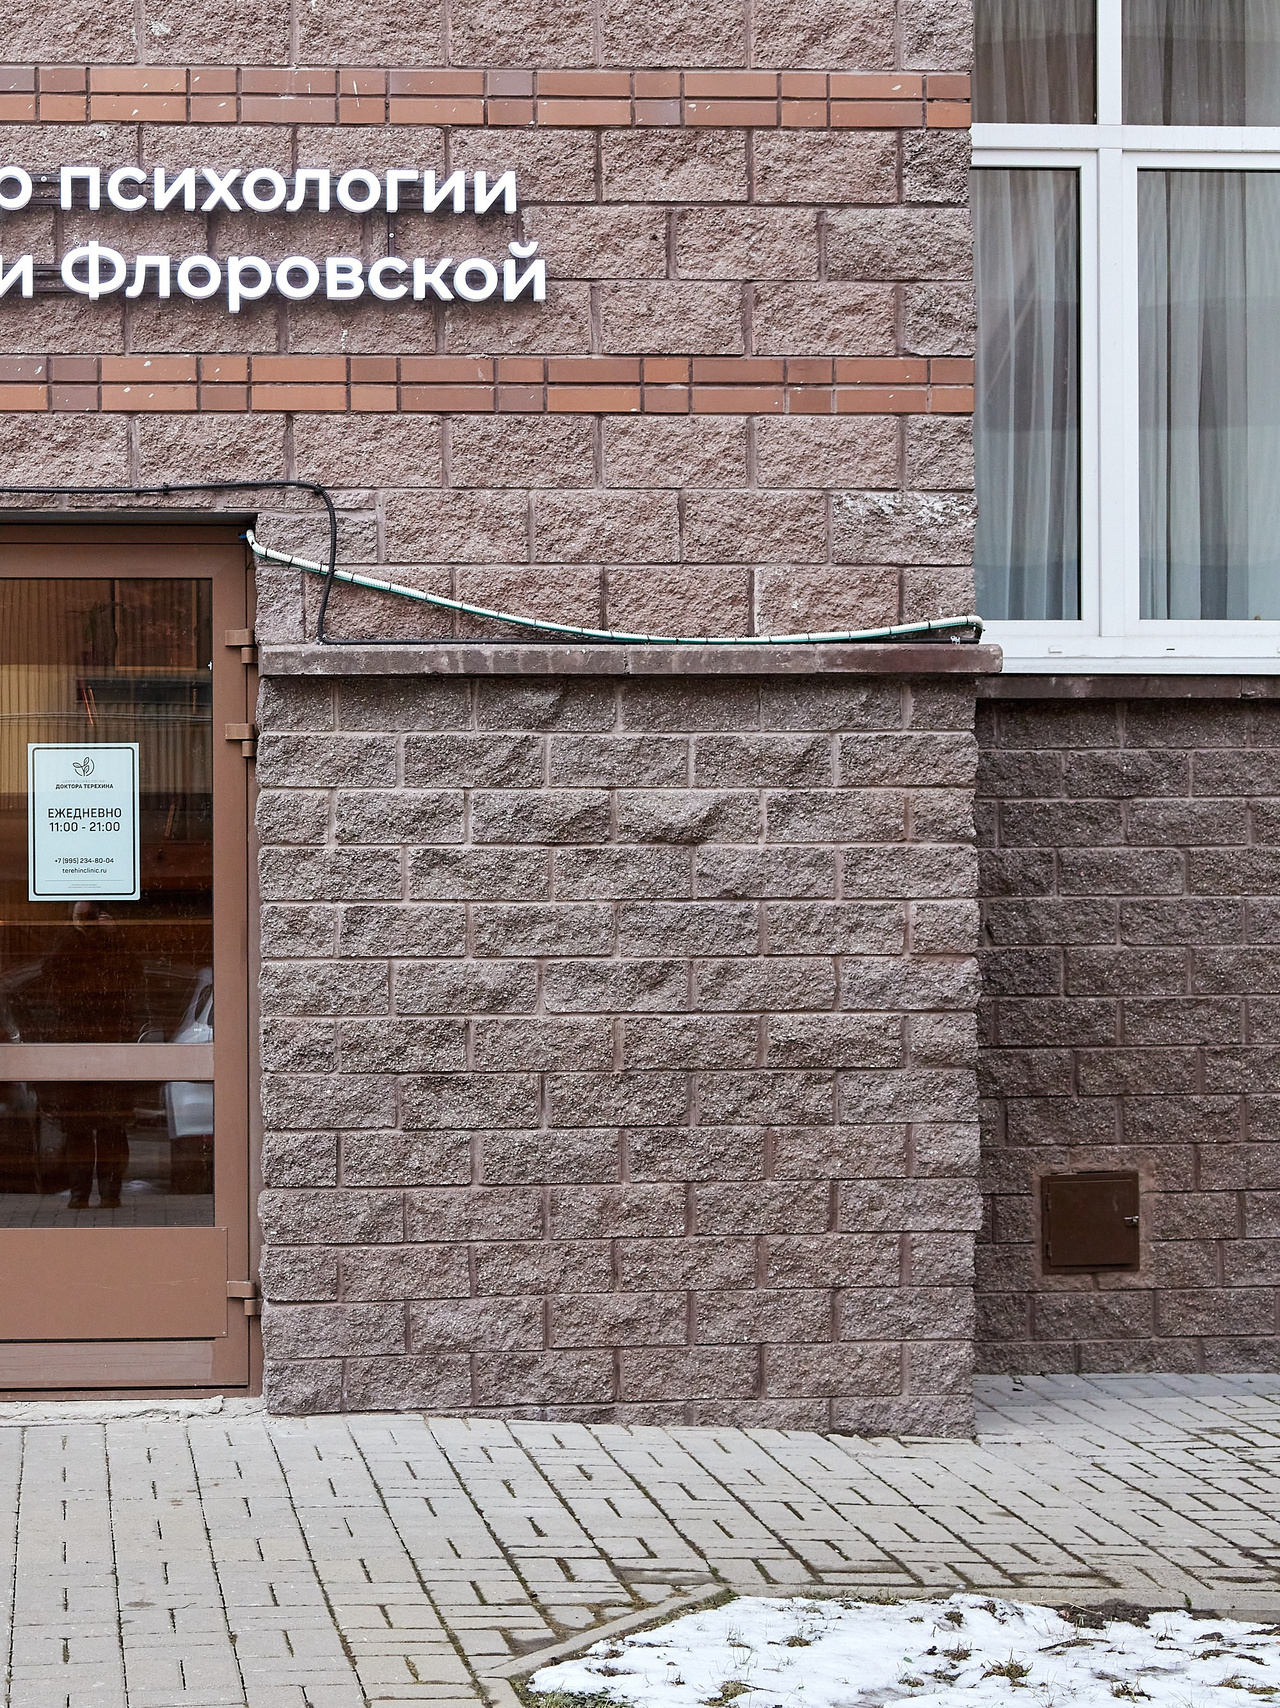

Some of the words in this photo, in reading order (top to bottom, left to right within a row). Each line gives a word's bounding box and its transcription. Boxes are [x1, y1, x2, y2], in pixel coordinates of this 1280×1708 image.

[60, 166, 517, 214] психологии
[60, 240, 546, 313] Флоровской
[48, 808, 122, 820] ЕЖЕДНЕВНО
[49, 822, 78, 832] 11:00
[89, 822, 120, 832] 21:00
